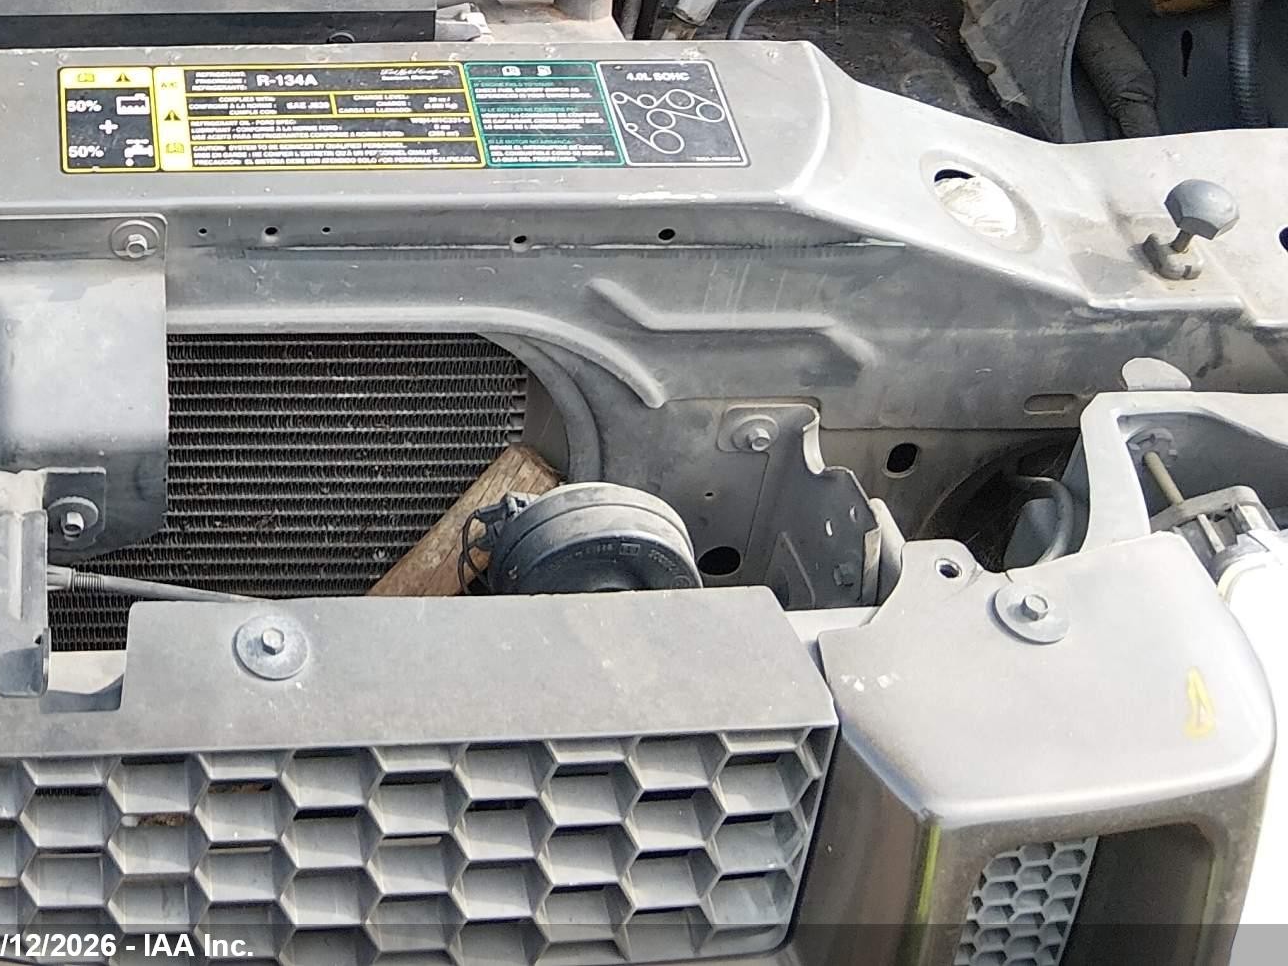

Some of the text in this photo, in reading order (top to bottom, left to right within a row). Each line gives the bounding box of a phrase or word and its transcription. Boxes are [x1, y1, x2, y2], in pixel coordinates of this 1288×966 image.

[256, 73, 318, 87] R-134A
[626, 72, 690, 81] 4.0L SOHC
[66, 100, 102, 112] 50%
[68, 145, 104, 158] 50%
